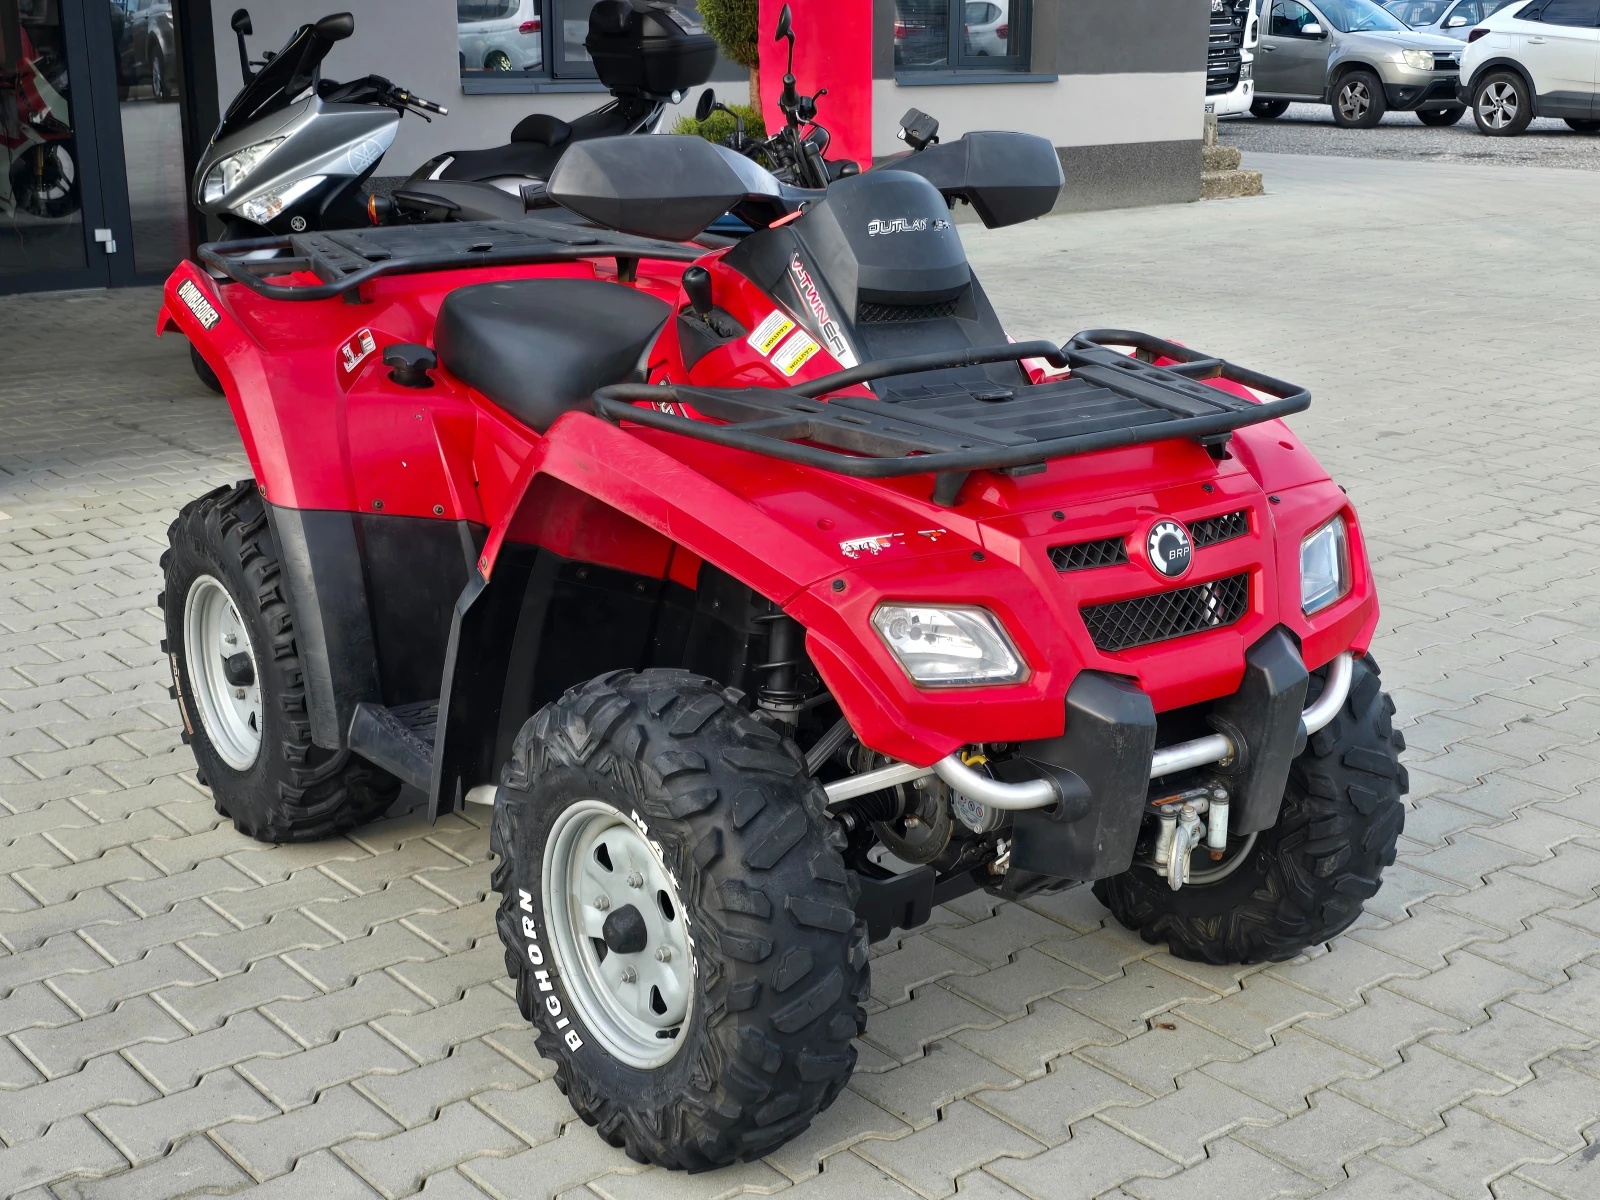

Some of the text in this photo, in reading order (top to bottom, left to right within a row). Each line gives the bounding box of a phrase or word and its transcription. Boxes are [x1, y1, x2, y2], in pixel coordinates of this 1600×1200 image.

[178, 280, 219, 330] BOMBARDIER
[765, 325, 788, 348] CAUTION
[789, 347, 813, 369] CAUTION
[1169, 546, 1190, 560] BRP
[518, 888, 584, 1053] BIGHORN
